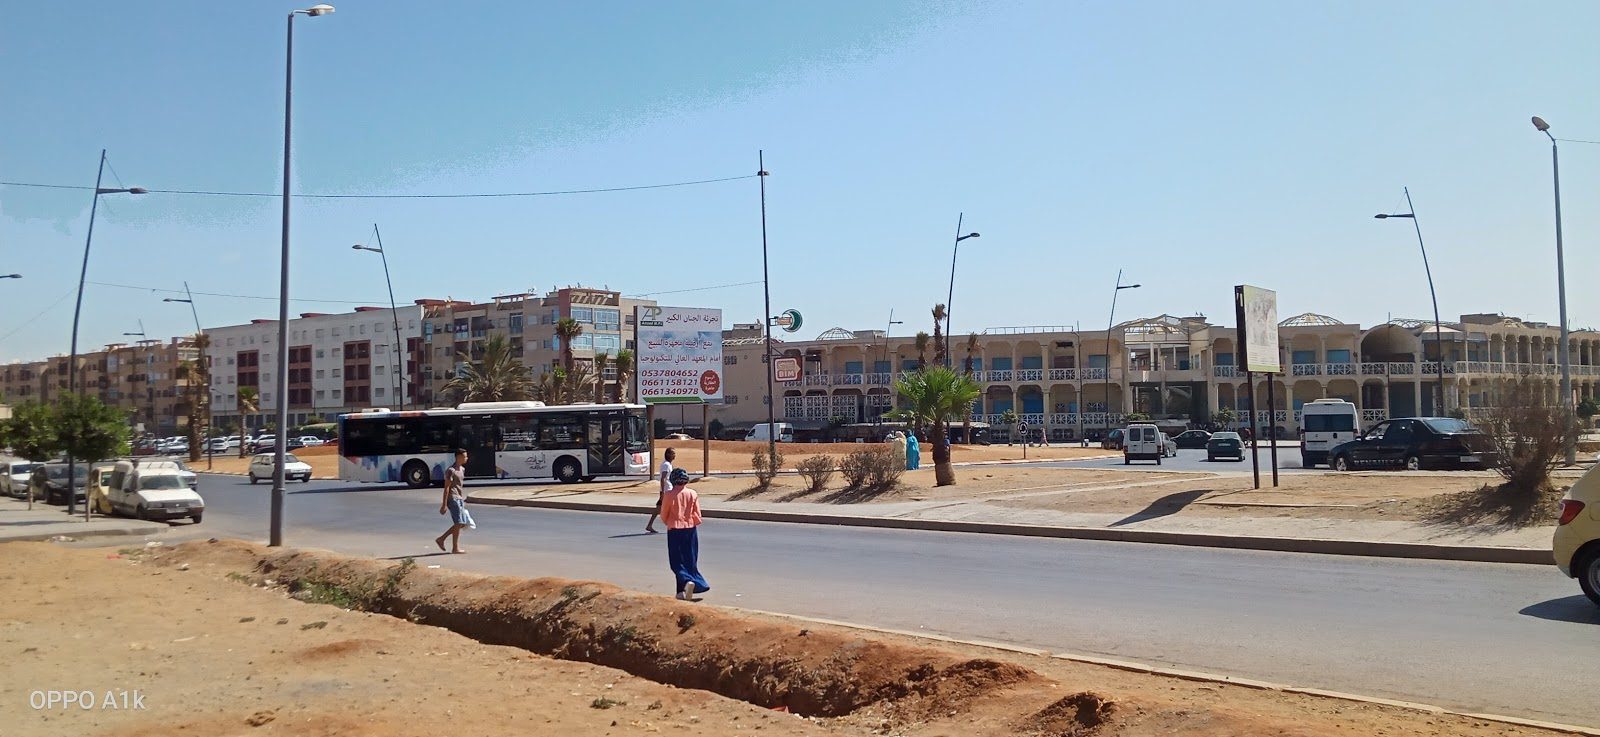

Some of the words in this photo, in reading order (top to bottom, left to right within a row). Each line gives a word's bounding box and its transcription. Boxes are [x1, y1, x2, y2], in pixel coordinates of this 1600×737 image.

[665, 313, 682, 323] الكبير
[683, 314, 701, 323] الجنان
[703, 314, 719, 324] تجزئة
[674, 354, 690, 366] العالي
[641, 388, 699, 396] 0661340978
